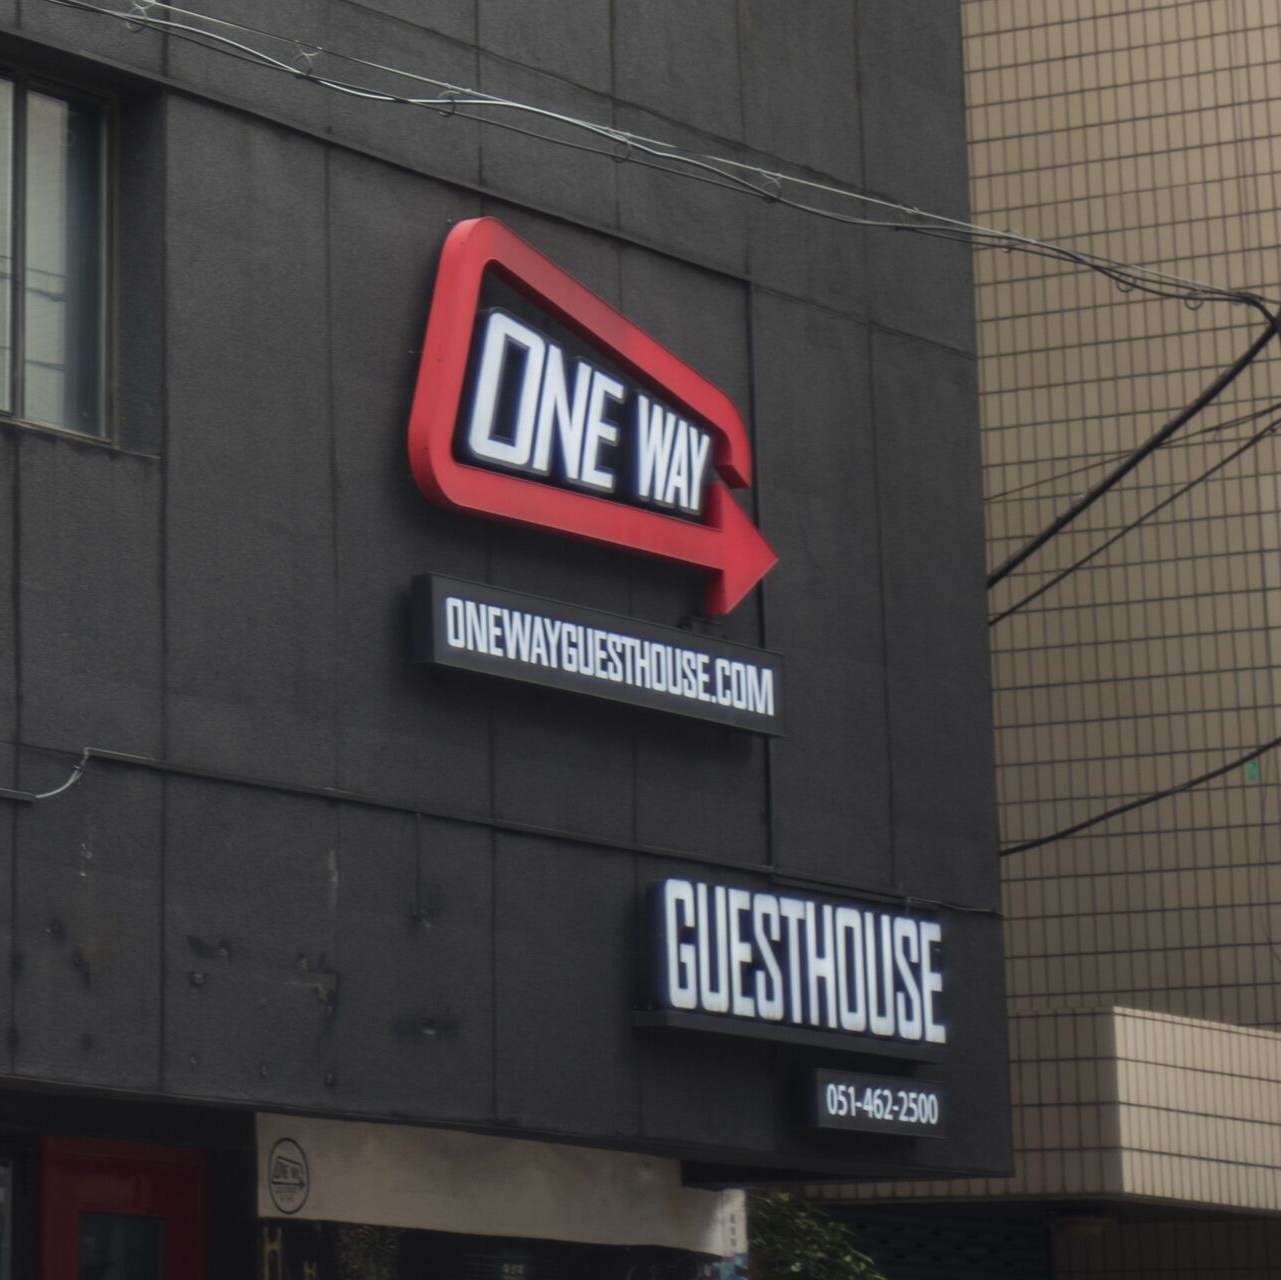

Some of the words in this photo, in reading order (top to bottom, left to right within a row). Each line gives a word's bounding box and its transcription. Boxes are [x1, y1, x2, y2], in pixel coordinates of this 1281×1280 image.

[467, 309, 625, 492] ONE
[636, 388, 712, 516] WAY
[444, 594, 776, 717] ONEWAYGUESTHOUSE.COM
[664, 877, 947, 1045] GUESTHOUSE
[825, 1082, 939, 1126] 051-462-2500
